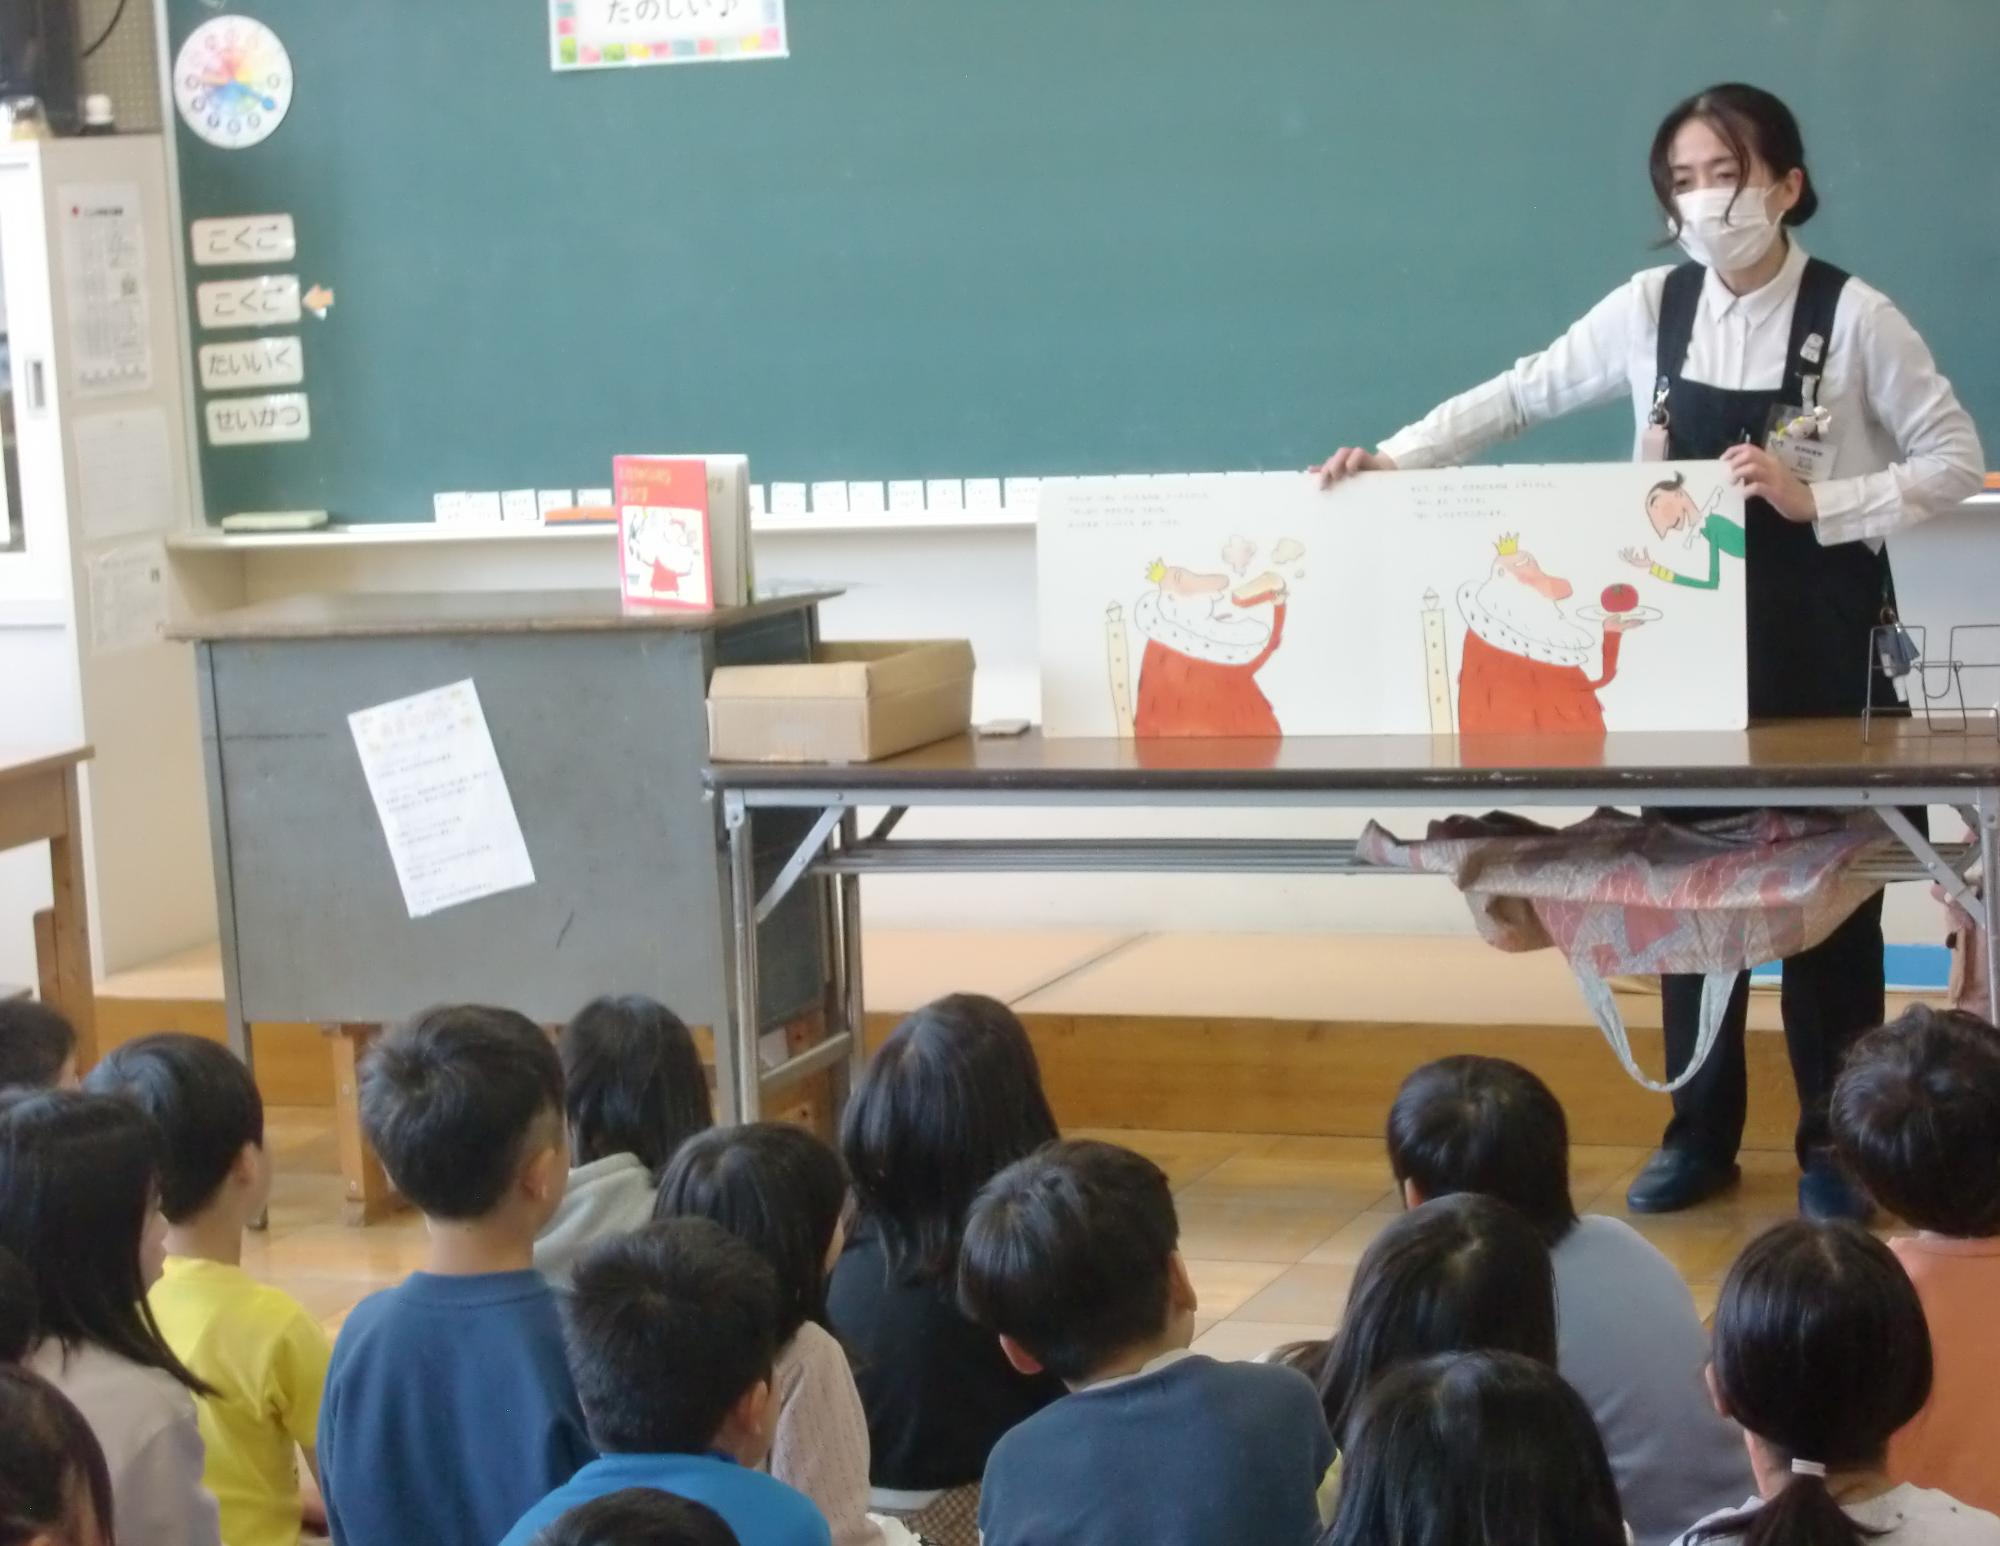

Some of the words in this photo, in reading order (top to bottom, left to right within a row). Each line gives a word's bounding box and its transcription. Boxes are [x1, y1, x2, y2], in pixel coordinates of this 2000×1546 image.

[208, 346, 293, 376] たいいく
[214, 404, 301, 432] せいかつ
